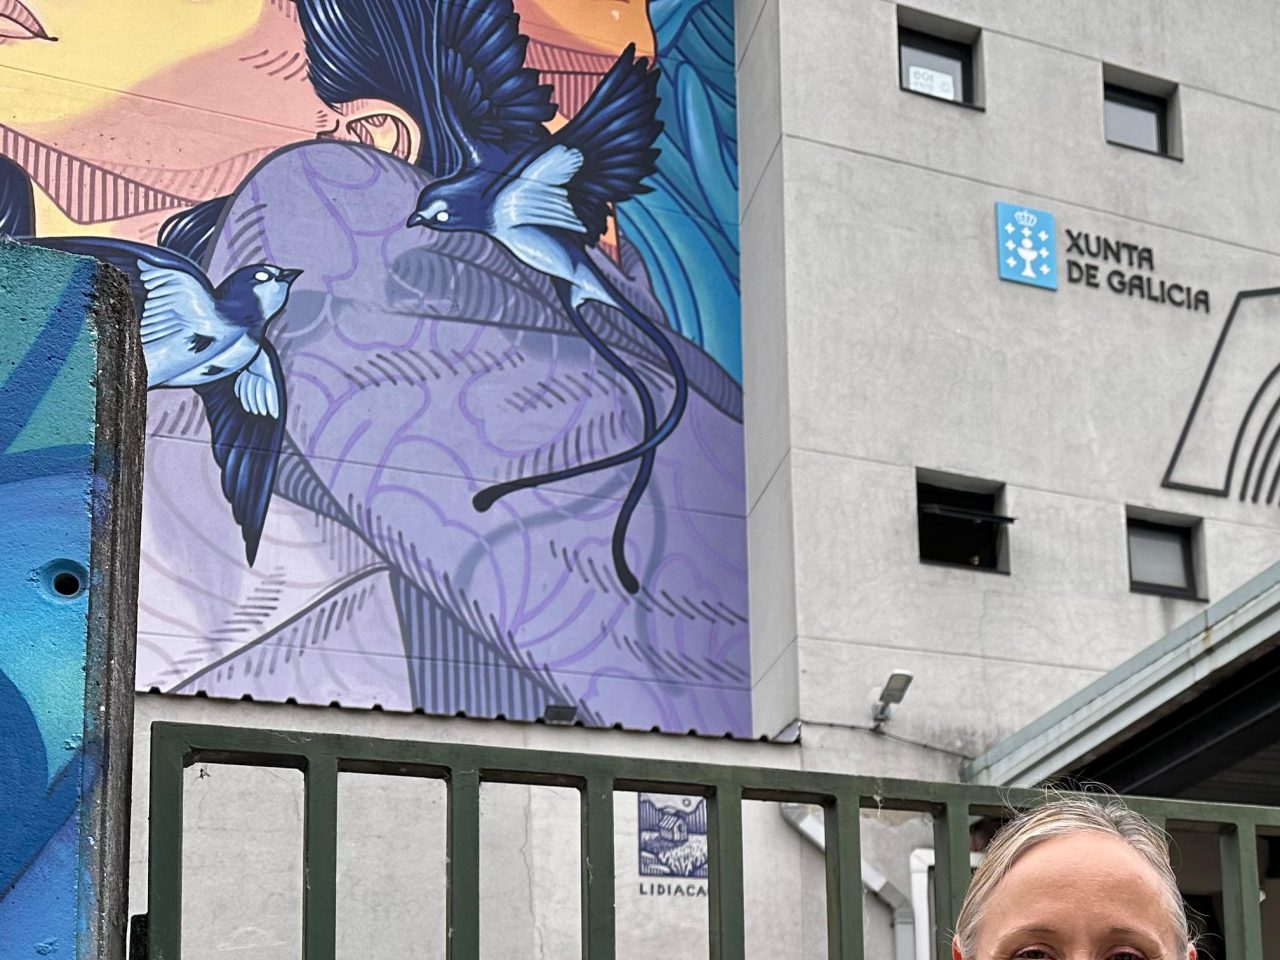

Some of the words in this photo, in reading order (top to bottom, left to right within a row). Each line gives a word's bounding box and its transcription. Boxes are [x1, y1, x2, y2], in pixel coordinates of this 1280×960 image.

[1065, 228, 1154, 271] XUNTA
[1066, 259, 1100, 288] DE
[1107, 270, 1211, 314] GALICIA
